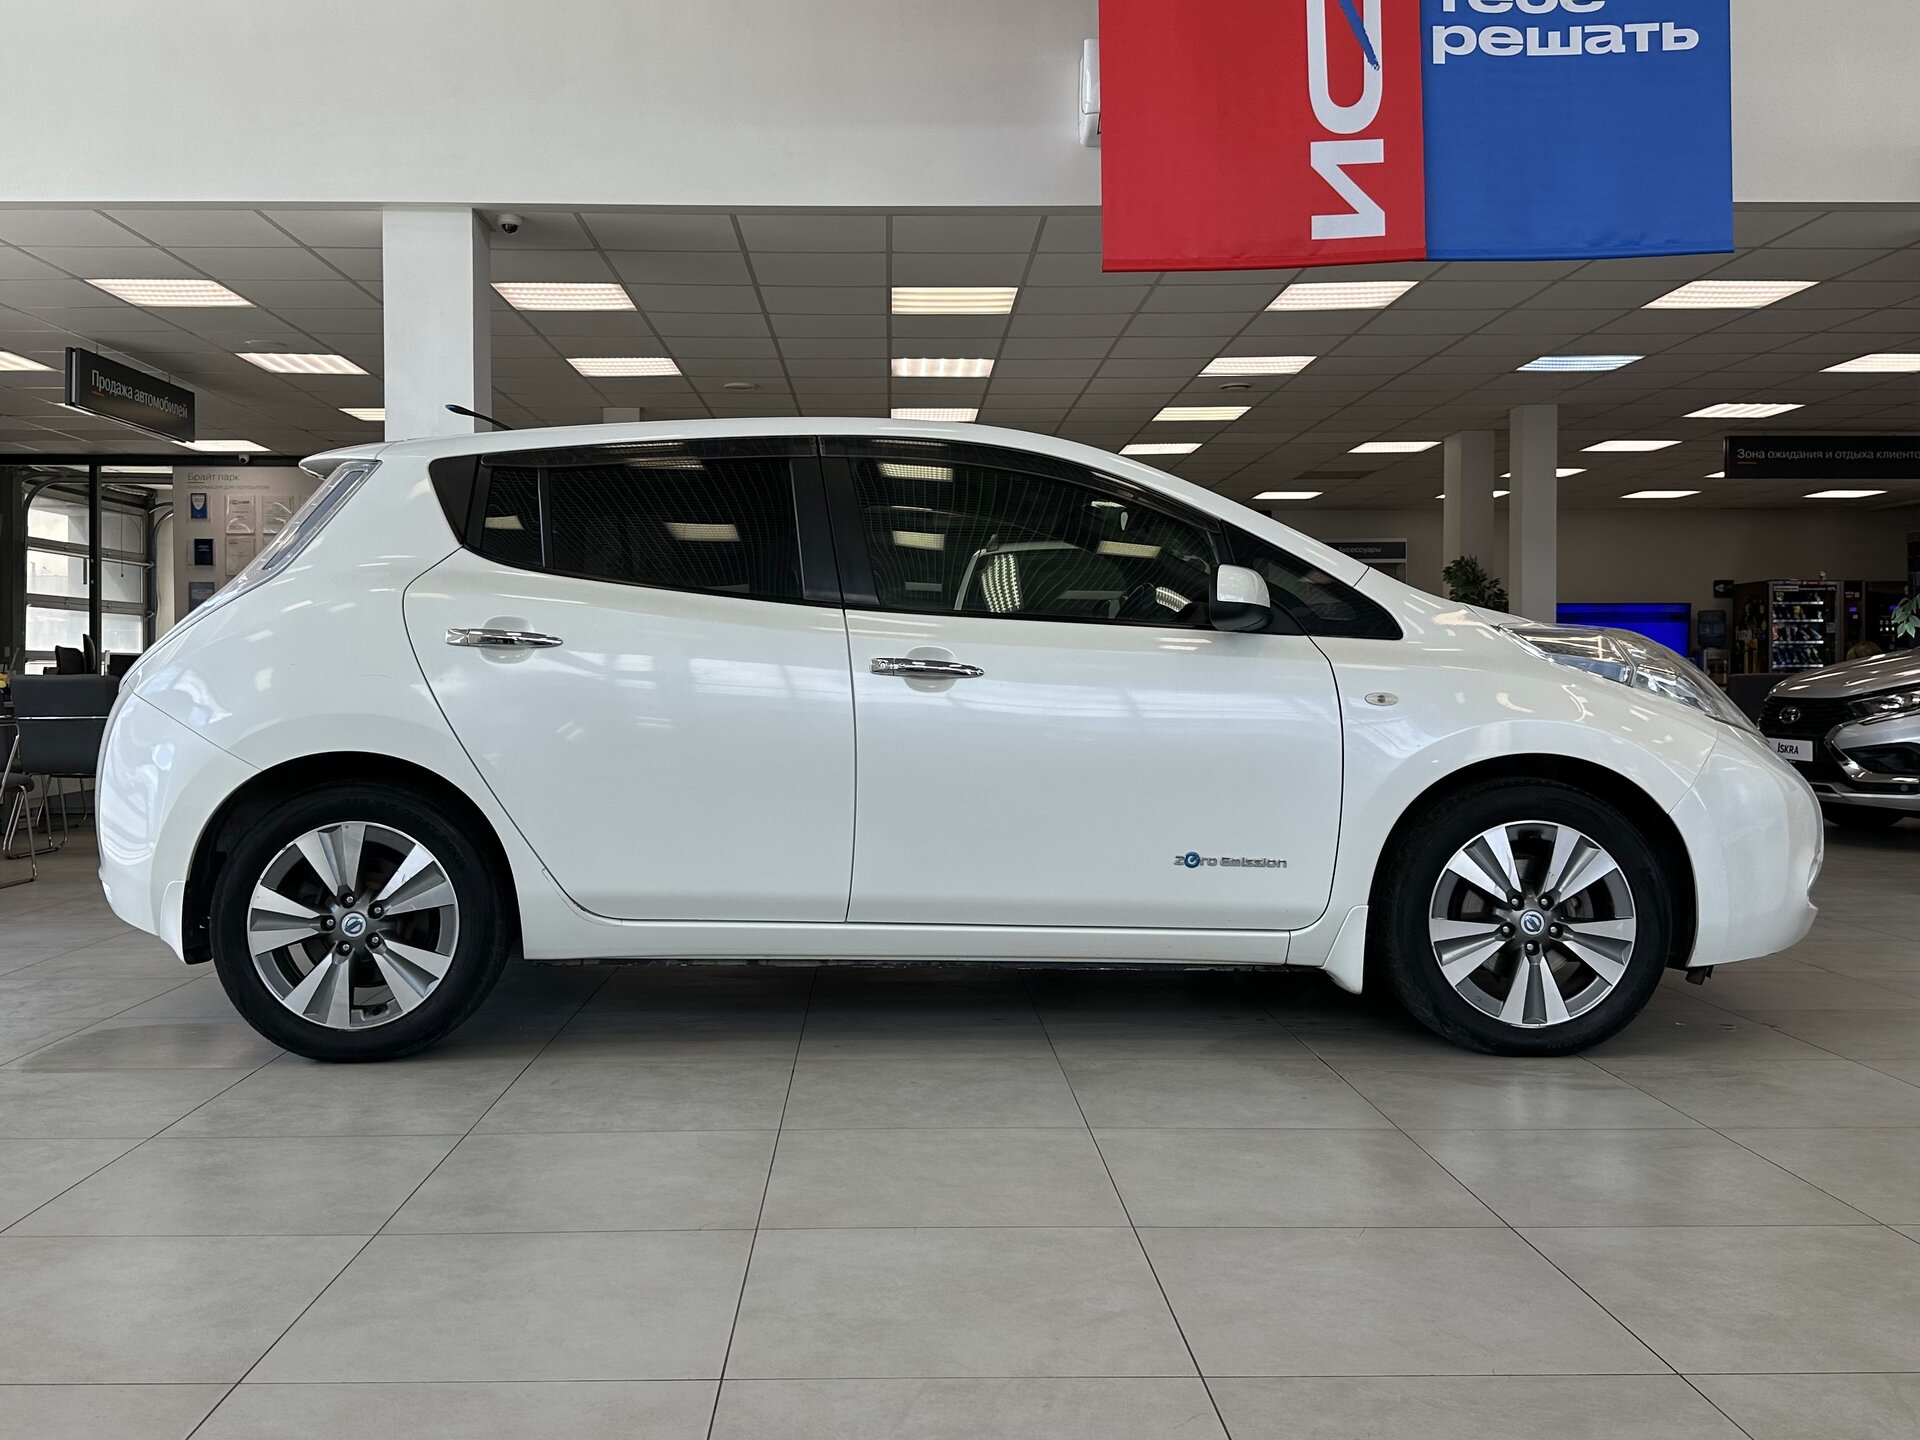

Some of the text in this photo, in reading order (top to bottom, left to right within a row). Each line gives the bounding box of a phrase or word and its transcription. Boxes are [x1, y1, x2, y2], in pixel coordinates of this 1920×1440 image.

[1432, 22, 1699, 65] решать
[91, 369, 188, 419] Продажа автомобилей
[1737, 448, 1765, 459] Зона
[1768, 451, 1823, 460] ожидания
[1825, 451, 1833, 459] и
[1835, 451, 1874, 460] отдыха
[187, 472, 240, 482] Брайт парк
[1338, 545, 1382, 554] Аксессуары
[1777, 742, 1799, 755] ISKRA
[1220, 857, 1287, 868] Emission
